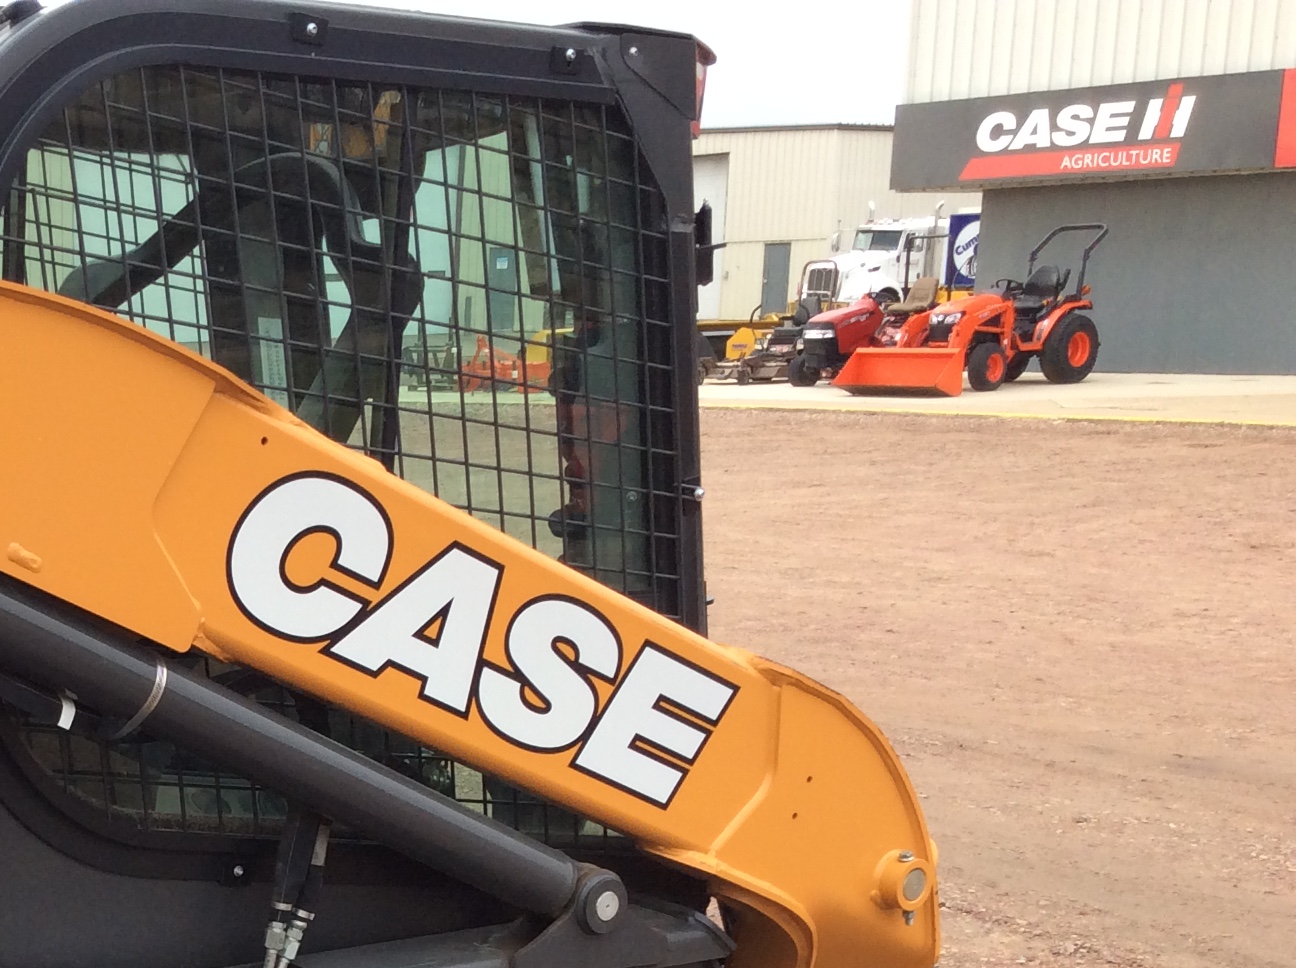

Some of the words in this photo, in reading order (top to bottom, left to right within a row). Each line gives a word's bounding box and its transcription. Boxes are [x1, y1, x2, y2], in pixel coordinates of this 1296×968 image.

[976, 100, 1136, 152] CASE
[1060, 148, 1172, 170] AGRICULTURE
[226, 470, 741, 810] CASE
